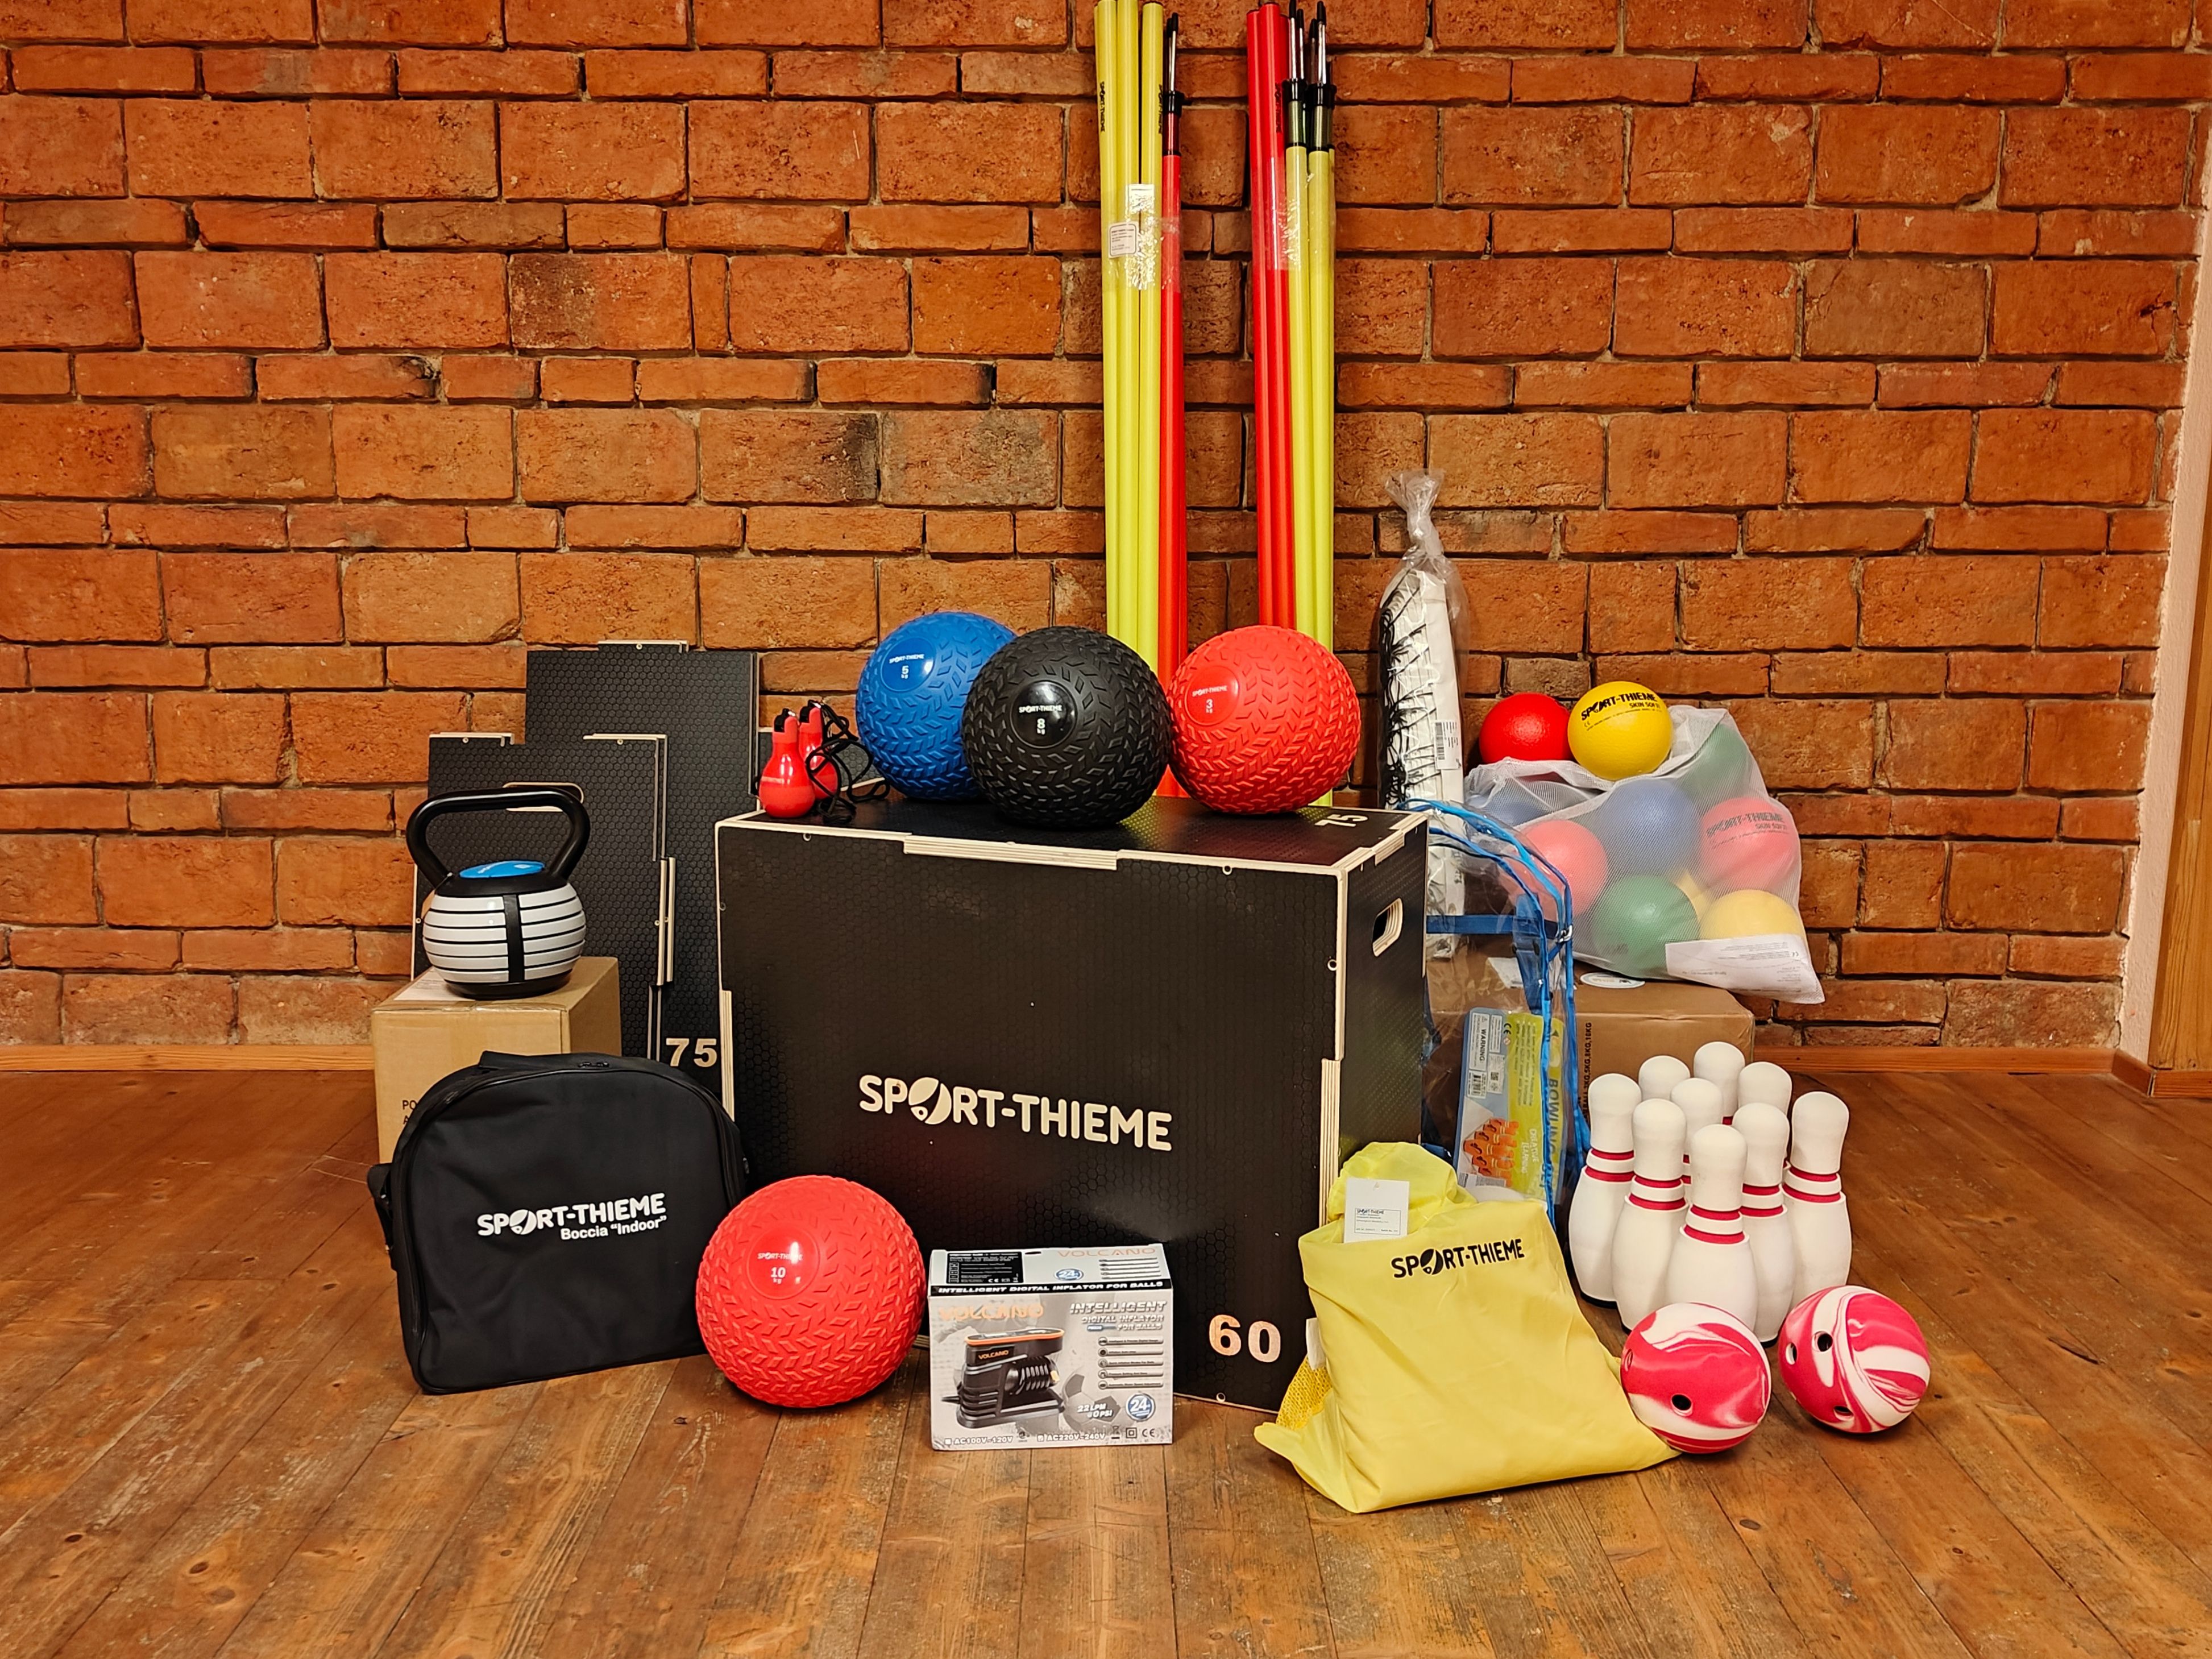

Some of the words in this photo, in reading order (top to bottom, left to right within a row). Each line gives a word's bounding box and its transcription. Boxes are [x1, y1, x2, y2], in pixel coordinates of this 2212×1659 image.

[889, 654, 924, 664] SPORT-THIEME
[902, 665, 909, 674] 5
[1192, 685, 1227, 698] SPORT-THIEME
[1019, 704, 1063, 713] SPORT-THIEME
[1206, 699, 1213, 708] 3
[1580, 692, 1658, 721] SPORT-THIEME
[1037, 718, 1045, 728] 8
[1314, 814, 1368, 827] 75
[666, 1038, 717, 1068] 75
[859, 1074, 1172, 1151] SPORT-THIEME
[477, 1192, 666, 1237] SPORT-THIEME
[560, 1225, 609, 1240] Boccia
[1057, 1247, 1156, 1257] VOLCANO
[1391, 1238, 1525, 1278] SPORT-THIEME
[770, 1267, 786, 1278] 10
[939, 1304, 1044, 1322] VOLCANO
[1069, 1301, 1167, 1315] INTELLIGENT
[1082, 1315, 1117, 1324] DIGITAL
[1119, 1314, 1164, 1323] INFLATOR
[1136, 1322, 1163, 1331] BALLS
[1209, 1314, 1281, 1363] 60
[978, 1349, 1009, 1359] VOLCANO
[1130, 1396, 1148, 1411] 24
